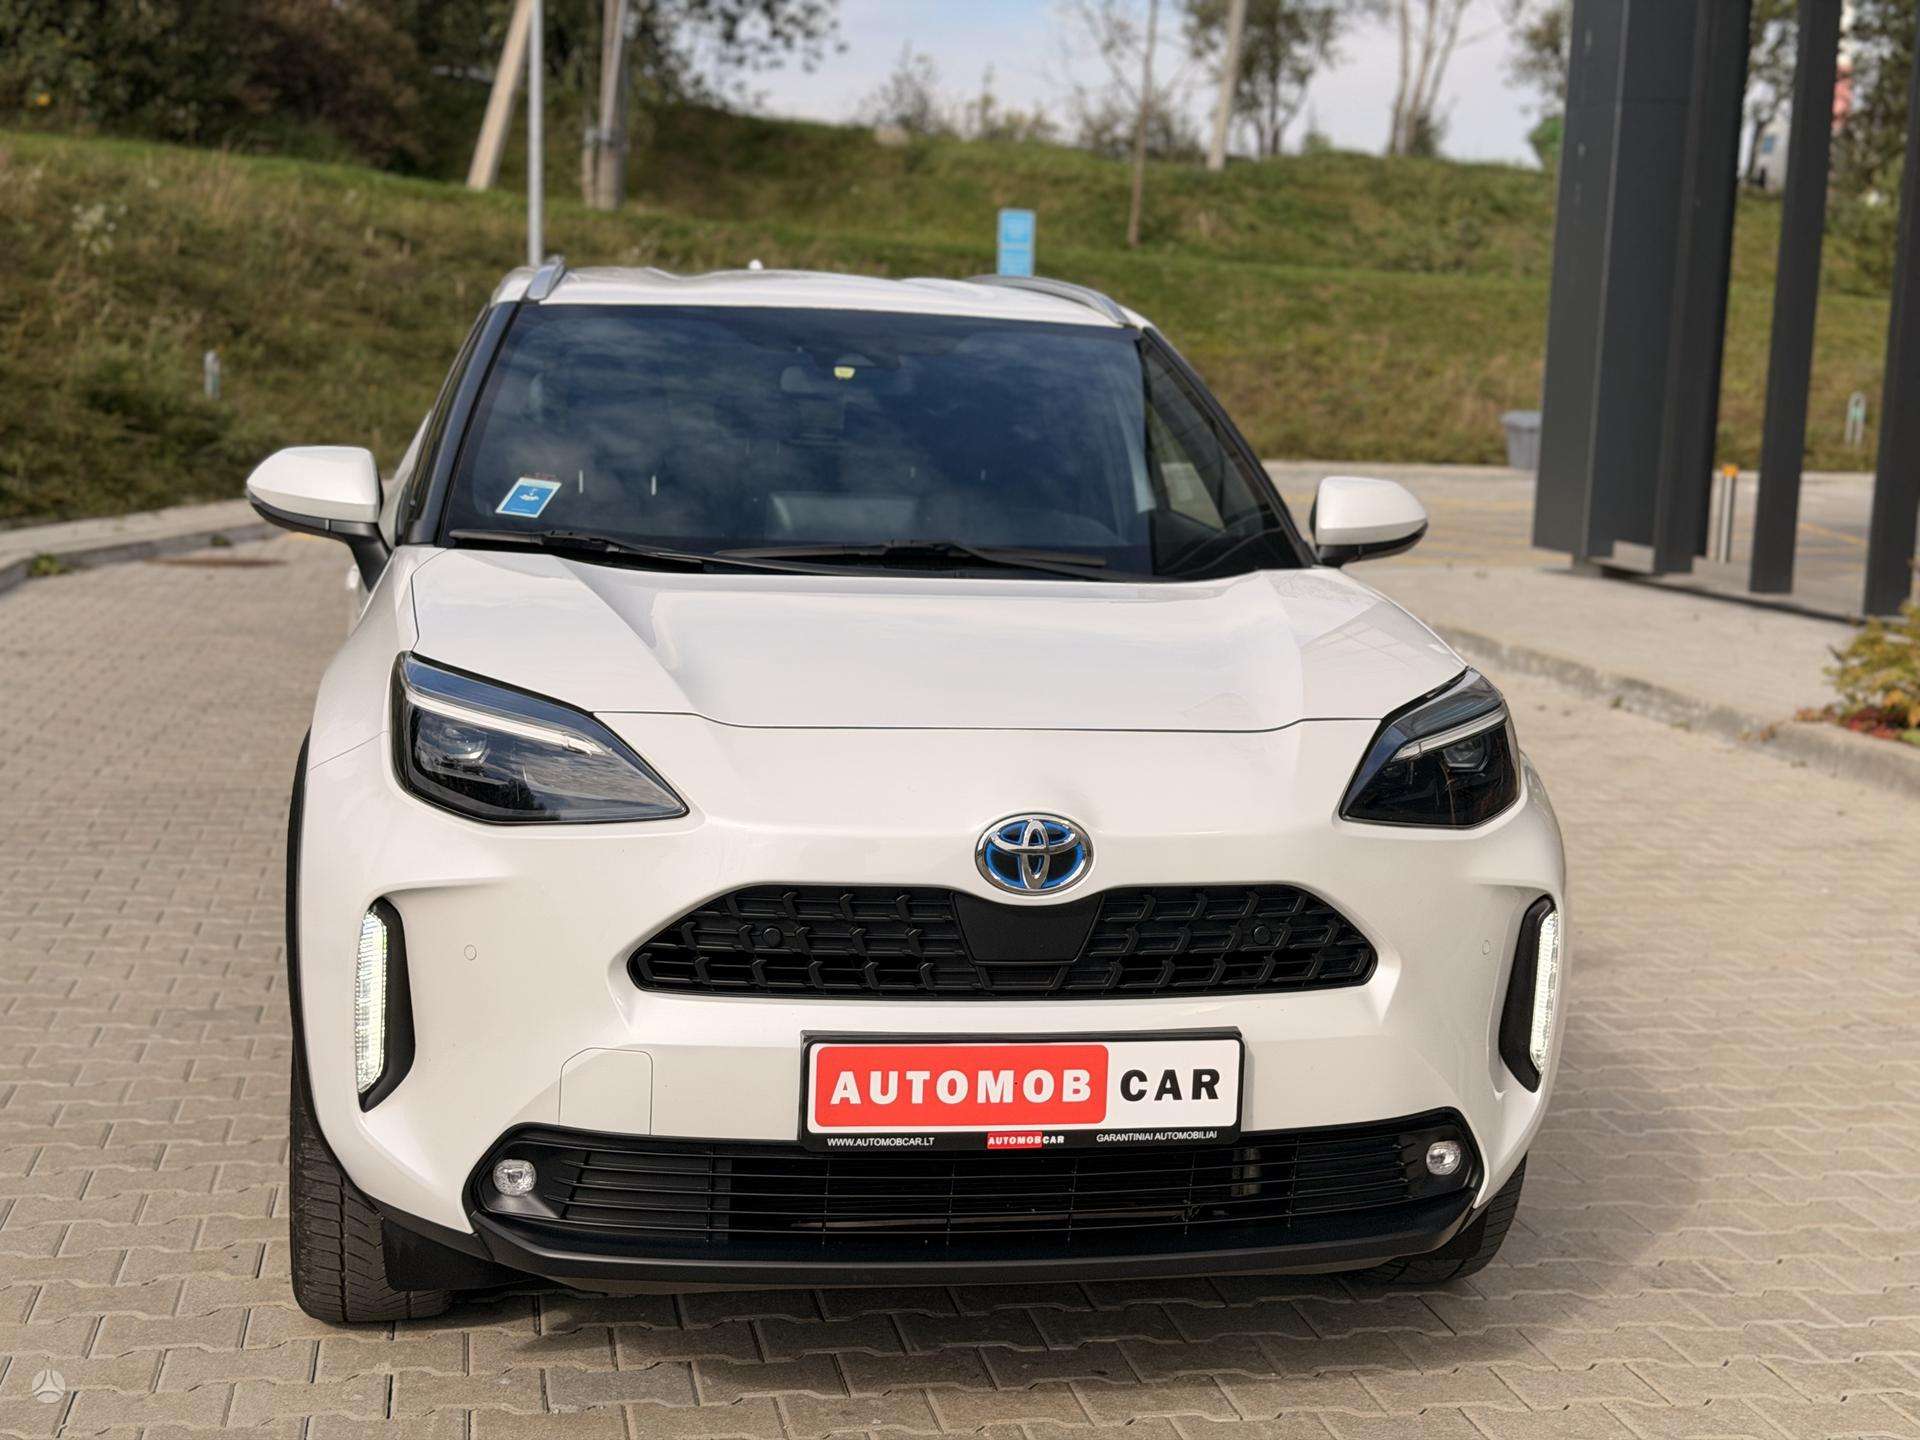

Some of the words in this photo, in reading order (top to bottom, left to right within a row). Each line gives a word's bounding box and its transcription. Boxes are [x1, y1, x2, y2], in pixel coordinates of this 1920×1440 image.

[830, 1069, 1092, 1105] AUTOMOB
[1120, 1068, 1220, 1102] CAR
[827, 1136, 935, 1148] WWW.AUTOMOBCAR.LT
[1096, 1133, 1153, 1143] GARANTINIAI
[1155, 1131, 1218, 1142] AUTOMOBILIAI
